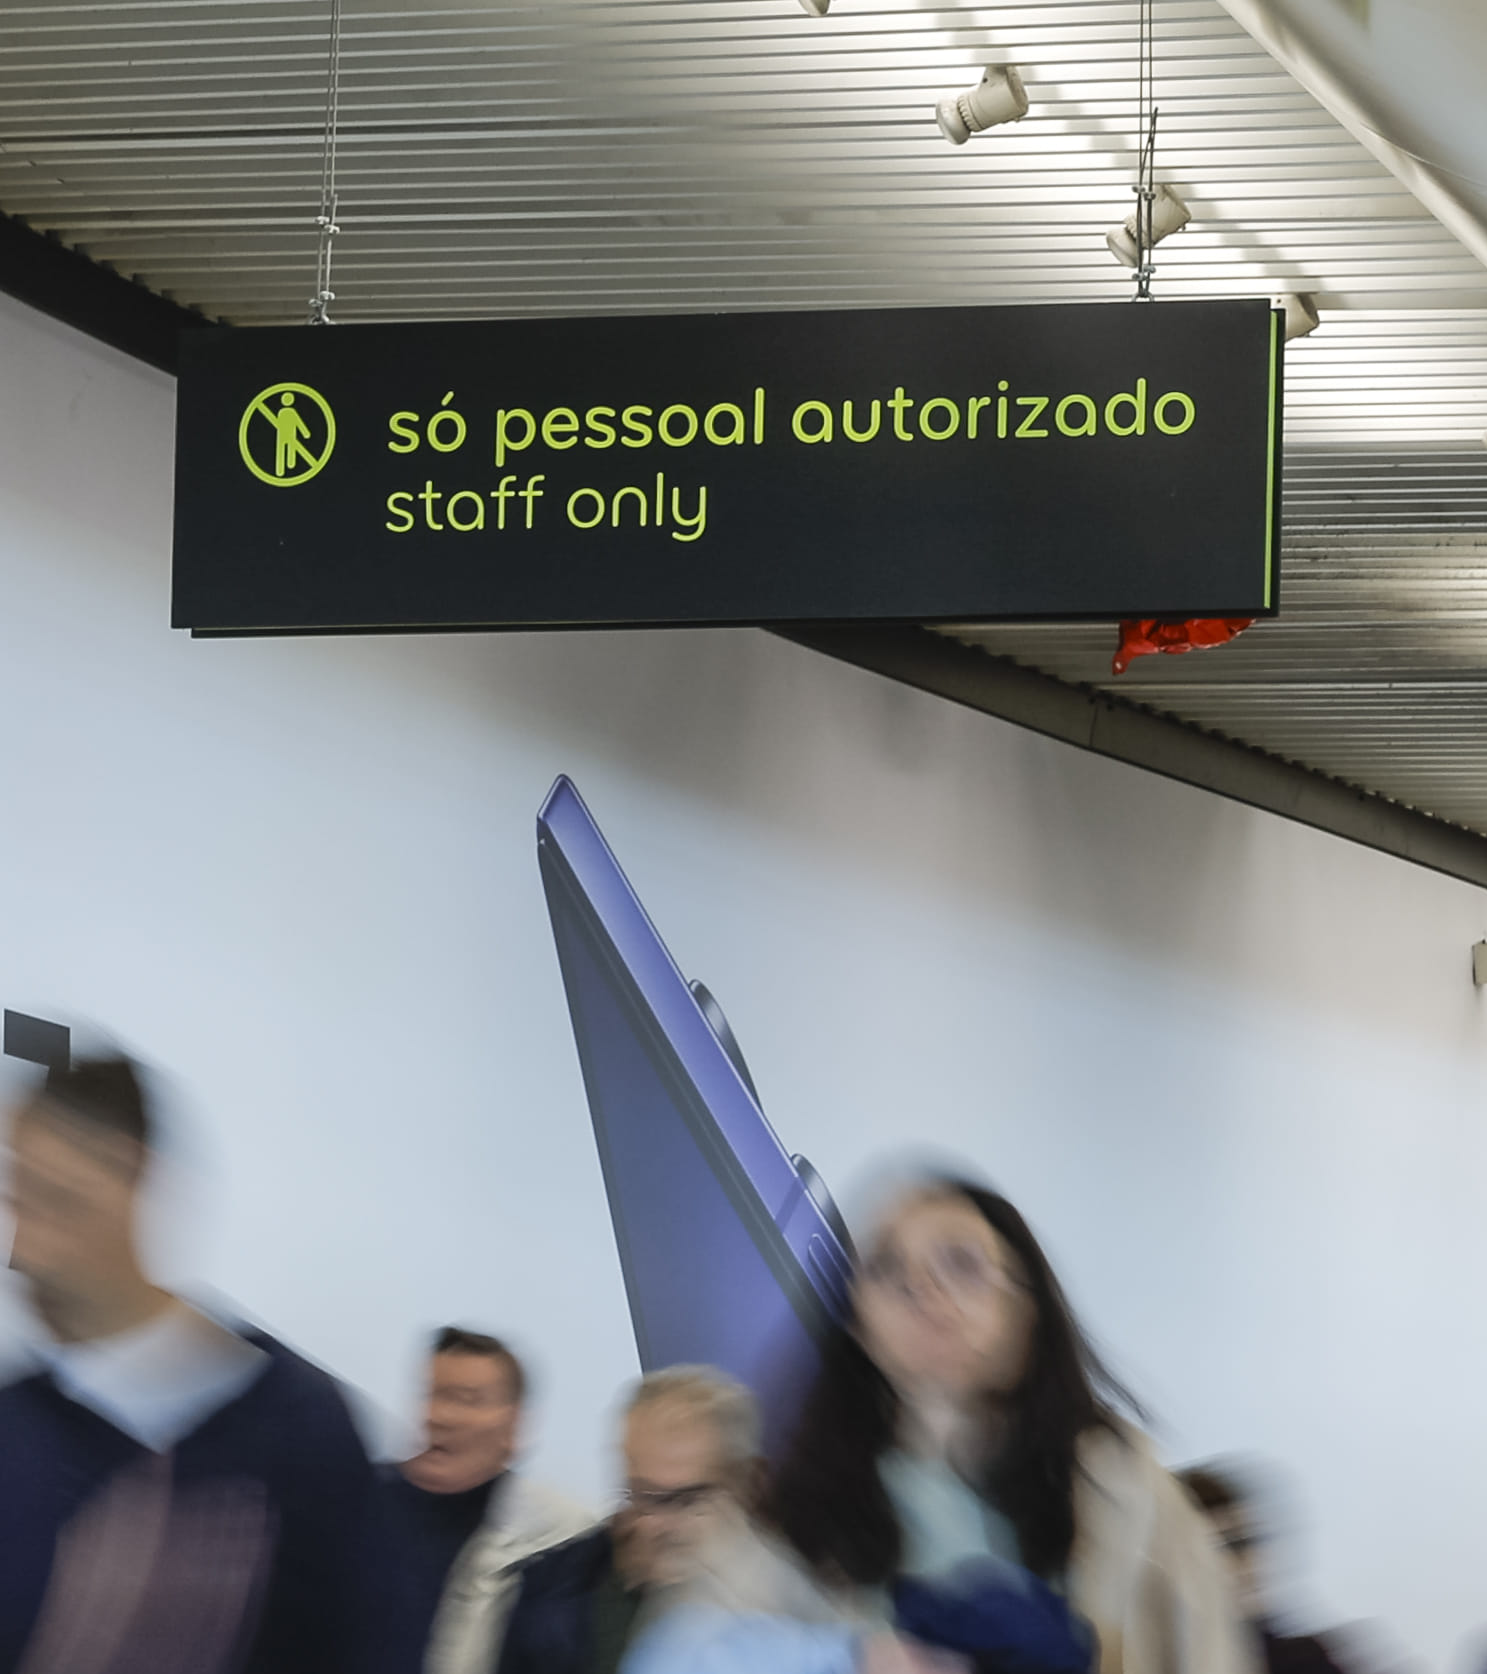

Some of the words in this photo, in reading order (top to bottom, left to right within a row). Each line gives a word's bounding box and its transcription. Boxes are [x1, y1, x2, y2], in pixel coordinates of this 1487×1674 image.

[387, 391, 467, 454] só
[495, 387, 765, 467] pessoal
[791, 377, 1196, 444] autorizado
[386, 474, 546, 533] staff
[566, 472, 707, 542] only
